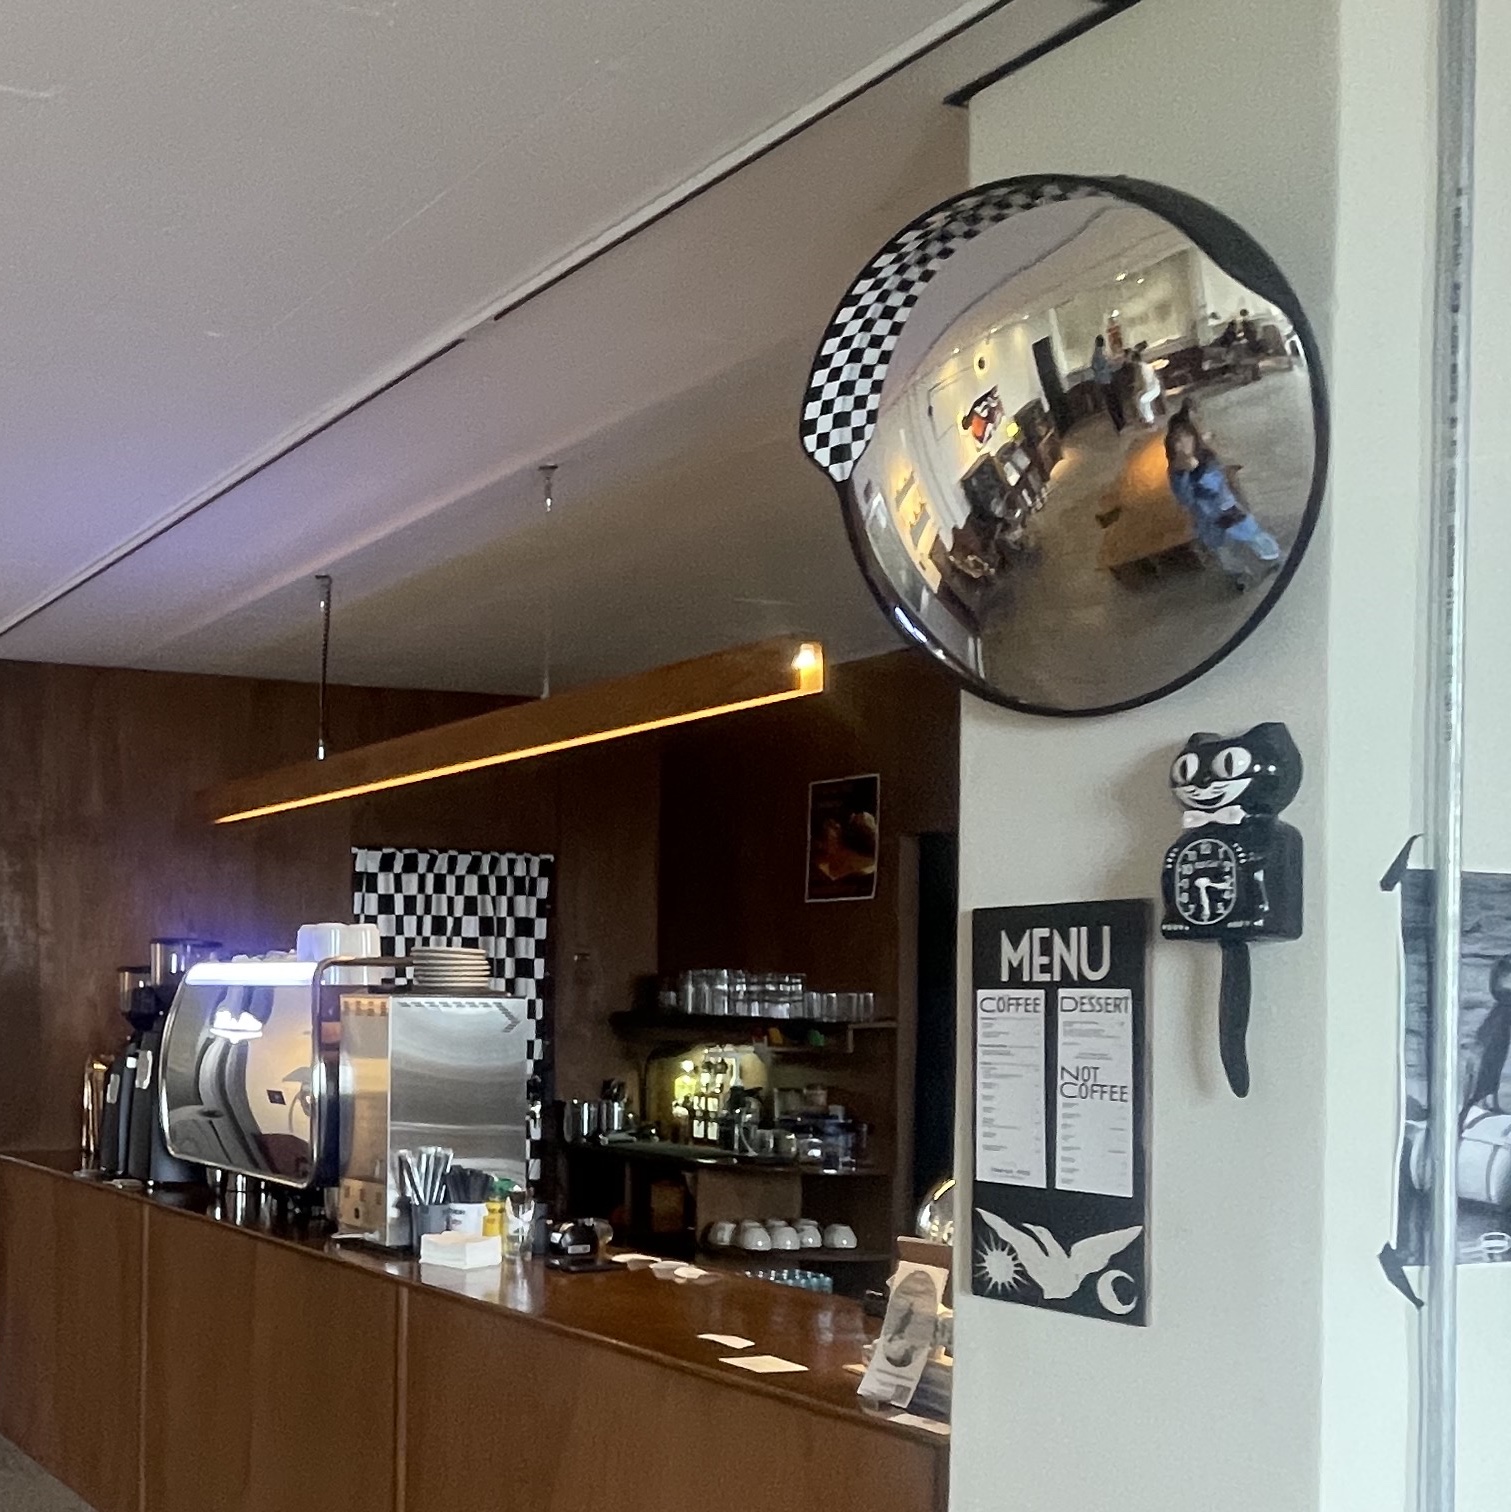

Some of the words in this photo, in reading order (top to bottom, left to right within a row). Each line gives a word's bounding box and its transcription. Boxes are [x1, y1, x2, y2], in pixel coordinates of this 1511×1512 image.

[1000, 925, 1111, 982] MENU
[979, 996, 1041, 1013] COFFEE
[1059, 995, 1130, 1014] DESSERT
[1060, 1065, 1100, 1082] NOT
[1059, 1081, 1129, 1103] COFFEE
